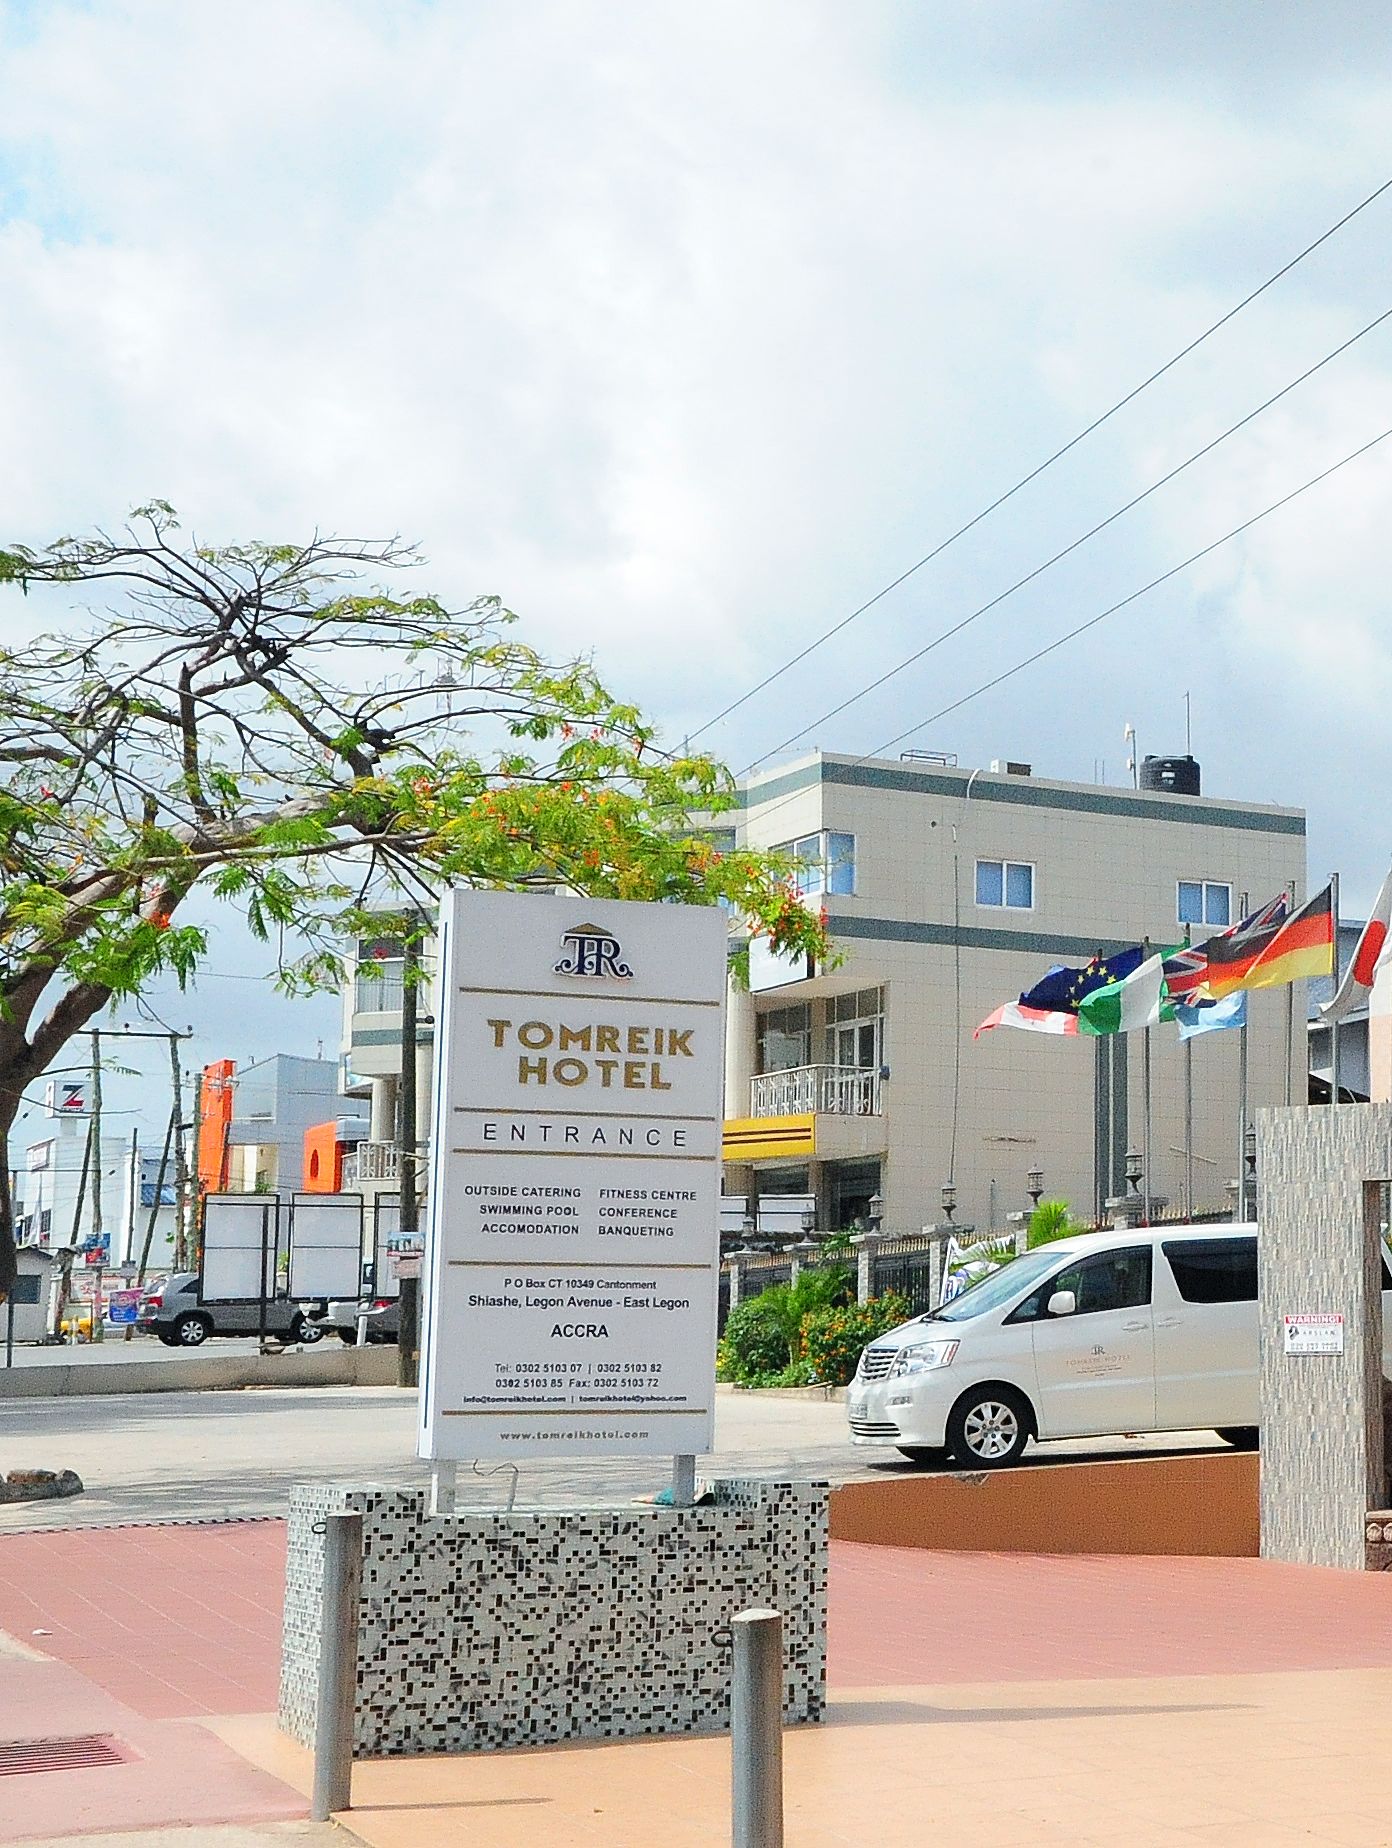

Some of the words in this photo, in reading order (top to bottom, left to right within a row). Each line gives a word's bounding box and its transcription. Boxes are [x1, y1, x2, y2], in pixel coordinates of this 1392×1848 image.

[487, 1019, 694, 1057] TOMREIK
[518, 1056, 672, 1090] HOTEL
[483, 1123, 687, 1147] ENTRANCE
[464, 1185, 518, 1197] OUTSIDE
[521, 1186, 582, 1198] CATERING
[599, 1188, 648, 1200] FITNESS
[650, 1190, 697, 1201] CENTRE
[479, 1204, 543, 1216] SWIMMING
[546, 1205, 580, 1217] POOL
[598, 1207, 678, 1219] CONFERENCE
[480, 1223, 579, 1235] ACCOMODATION
[598, 1225, 674, 1237] BANQUETING
[504, 1278, 512, 1289] P
[513, 1278, 524, 1289] O
[525, 1278, 546, 1289] Box
[548, 1278, 564, 1289] CT
[565, 1279, 595, 1289] 10349
[596, 1279, 657, 1290] Cantonment
[467, 1294, 522, 1309] Shiashe,
[525, 1295, 565, 1310] Legon
[566, 1295, 613, 1308] Avenue
[623, 1296, 650, 1309] East
[652, 1296, 690, 1312] Legon
[550, 1323, 610, 1339] ACCRA
[515, 1363, 541, 1373] 0302
[542, 1363, 568, 1373] 5103
[569, 1363, 583, 1373] 07
[597, 1363, 621, 1373] 0302
[623, 1363, 648, 1373] 5103
[523, 1378, 548, 1389] 5103
[568, 1377, 591, 1388] Fax:
[593, 1377, 618, 1388] 0302
[620, 1377, 645, 1388] 5103
